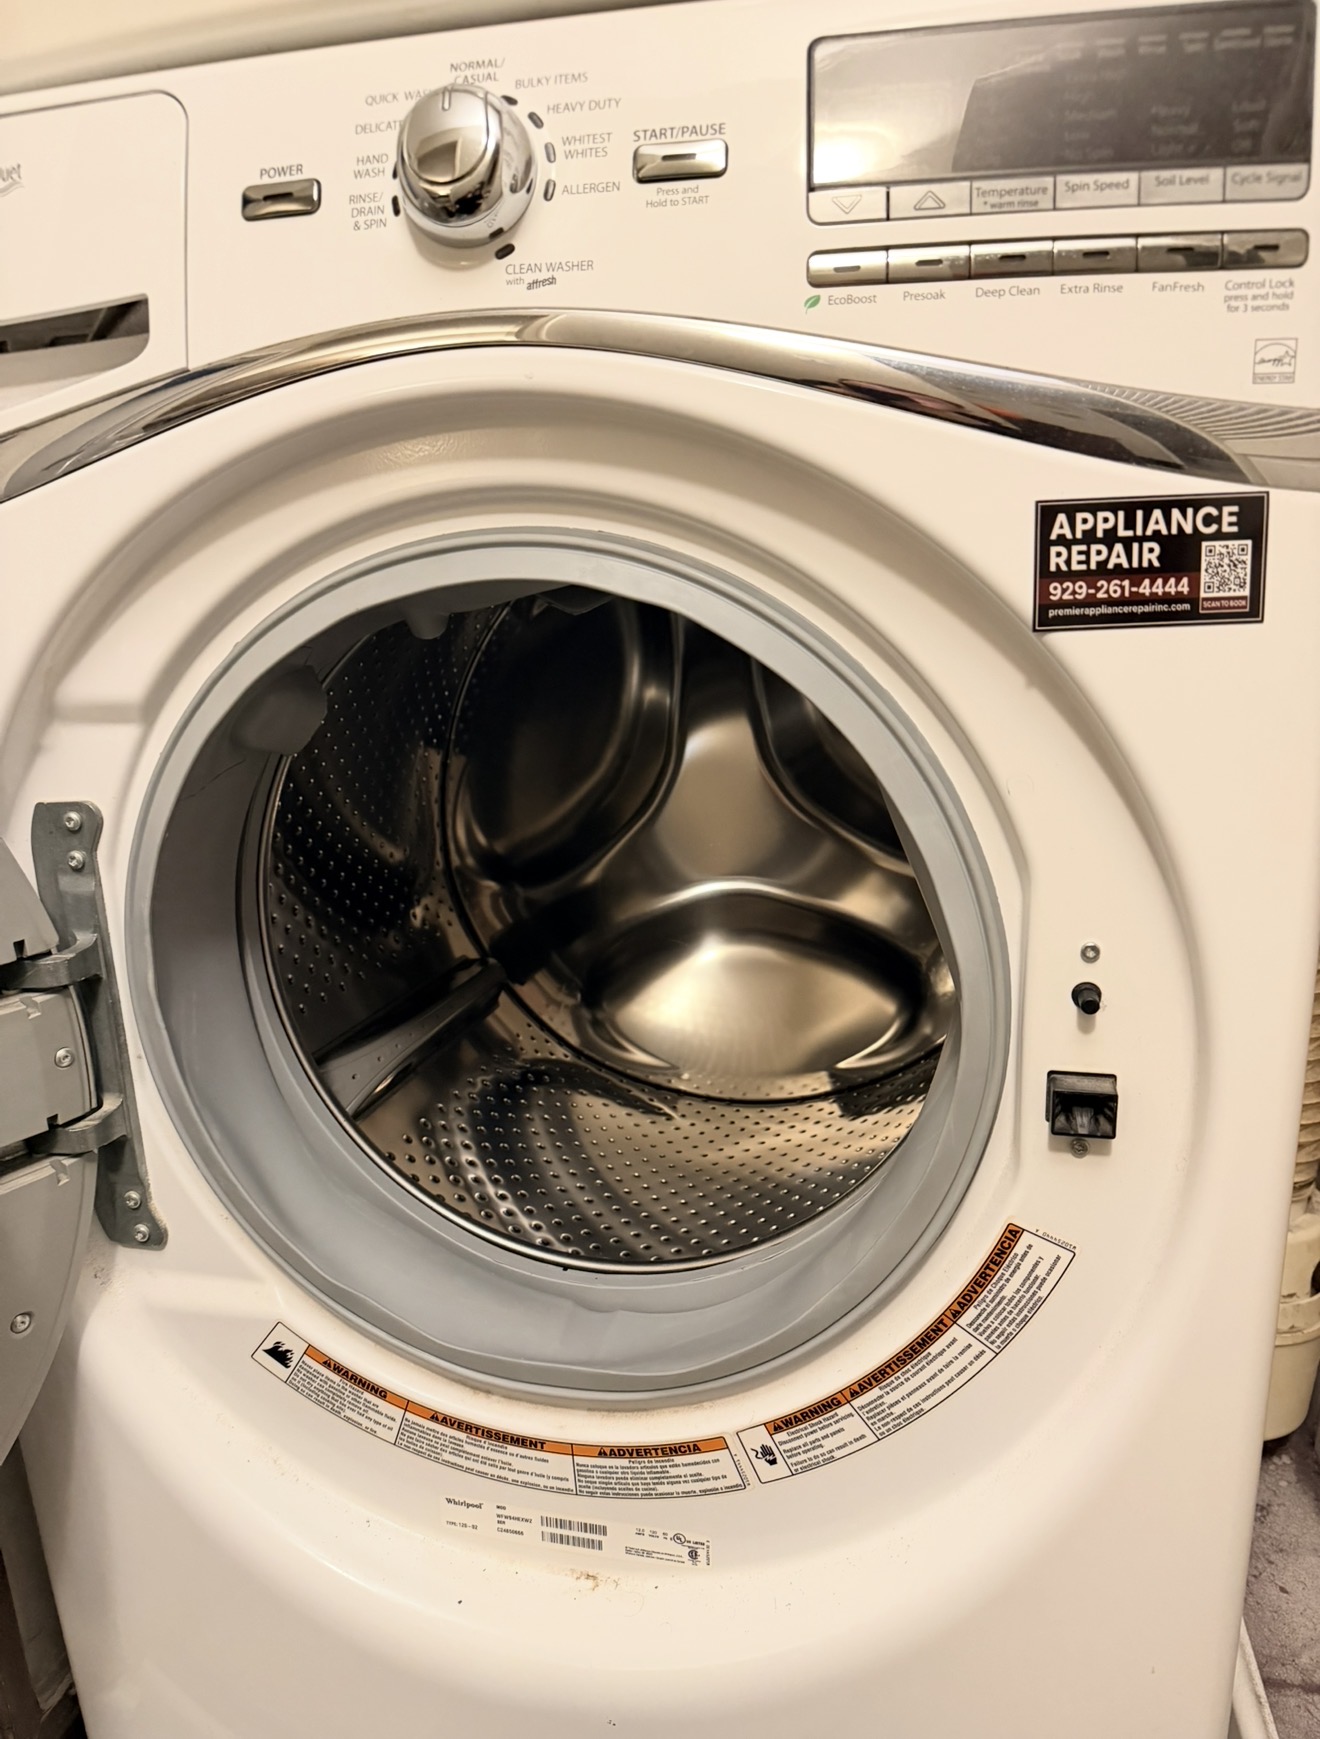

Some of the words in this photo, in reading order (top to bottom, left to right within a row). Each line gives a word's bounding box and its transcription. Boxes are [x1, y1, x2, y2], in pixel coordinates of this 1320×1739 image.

[450, 58, 505, 73] NORMAL/
[454, 72, 499, 86] CASUAL
[515, 76, 551, 90] BULKY
[554, 72, 588, 85] ITEMS
[365, 92, 399, 106] QUICK
[547, 101, 585, 114] HEAVY
[588, 98, 621, 111] DUTY
[562, 132, 613, 146] WHITEST
[633, 123, 726, 142] START/PAUSE
[357, 153, 389, 166] HAND
[564, 146, 608, 160] WHITES
[260, 164, 303, 180] POWER
[353, 168, 385, 180] WASH
[1231, 171, 1262, 186] Cycle
[1266, 169, 1302, 186] Signal
[1064, 181, 1090, 194] Spin
[1093, 178, 1129, 192] Speed
[1154, 174, 1176, 187] Soil
[1179, 173, 1209, 186] Level
[561, 181, 620, 195] ALLERGEN
[656, 187, 679, 196] Press
[681, 185, 699, 194] and
[975, 185, 1048, 200] Temperature
[349, 192, 383, 205] RINSE/
[646, 198, 667, 208] Hold
[670, 198, 679, 206] to
[681, 196, 709, 205] START
[990, 201, 1015, 210] warm
[1017, 199, 1039, 208] rinse
[351, 205, 384, 218] DRAIN
[353, 220, 361, 231] &
[363, 218, 387, 230] SPIN
[505, 263, 542, 275] CLEAN
[545, 260, 594, 272] WASHER
[505, 277, 524, 286] with
[526, 275, 557, 290] affresh
[1060, 283, 1089, 294] Extra
[1093, 282, 1123, 293] Rinse
[1152, 281, 1204, 293] FanFresh
[1225, 278, 1266, 291] Control
[1268, 278, 1295, 289] Lock
[903, 289, 945, 301] Presoak
[975, 287, 1004, 299] Deep
[1008, 285, 1040, 296] Clean
[1223, 292, 1249, 303] press
[1251, 291, 1269, 301] and
[1271, 291, 1294, 300] hold
[827, 294, 877, 306] EcoBoost
[1226, 303, 1240, 312] for
[1242, 303, 1248, 312] 3
[1250, 302, 1290, 312] seconds
[1049, 505, 1240, 540] APPLIANCE
[1049, 541, 1161, 572] REPAIR
[1049, 576, 1190, 601] 929-261-4444
[1048, 602, 1191, 619] premierappliancerepairinc.com
[1203, 600, 1220, 609] SCAN
[1221, 600, 1229, 608] TO
[1229, 599, 1246, 608] BOOK
[955, 1227, 1021, 1310] ADVERTENCIA
[855, 1318, 949, 1397] AVERTISSEMENT
[332, 1363, 388, 1399] WARNING
[781, 1397, 842, 1428] WARNING
[777, 1433, 803, 1446] Disconnect
[803, 1428, 818, 1437] power
[817, 1422, 833, 1431] before
[832, 1412, 854, 1424] servicing.
[786, 1425, 808, 1437] Electrical
[808, 1419, 822, 1428] Shock
[822, 1411, 838, 1422] Hazard
[440, 1416, 546, 1450] AVERTISSEMENT
[782, 1444, 802, 1454] Replace
[808, 1437, 820, 1445] parts
[829, 1427, 845, 1437] panels
[608, 1443, 702, 1457] ADVERTENCIA
[785, 1451, 801, 1459] before
[801, 1443, 824, 1454] operating.
[790, 1458, 807, 1467] Failure
[834, 1442, 848, 1451] result
[853, 1433, 866, 1442] death
[445, 1497, 484, 1510] Whirlpool
